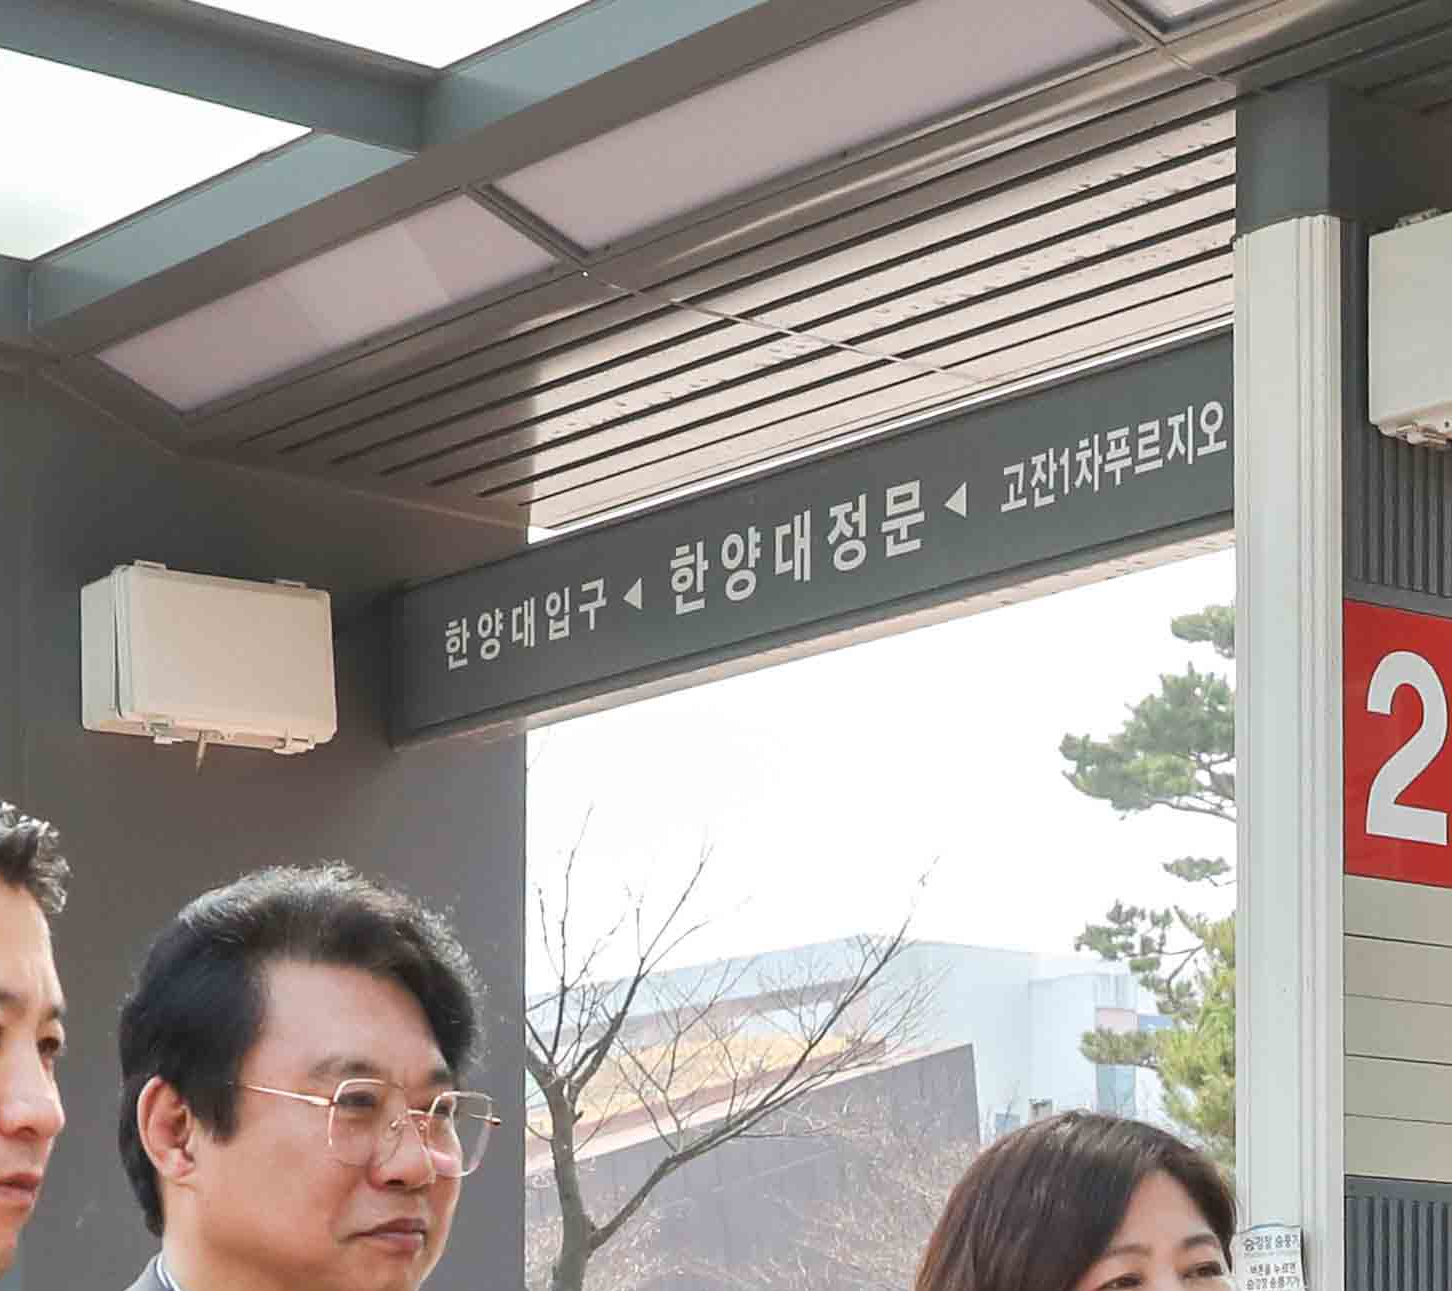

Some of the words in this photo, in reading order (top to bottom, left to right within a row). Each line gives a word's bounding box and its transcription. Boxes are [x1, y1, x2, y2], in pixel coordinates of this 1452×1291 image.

[999, 399, 1229, 515] 고잔1차푸르지오
[668, 479, 927, 615] 한양대정문
[444, 576, 609, 671] 한양대입구
[1364, 649, 1449, 847] 2
